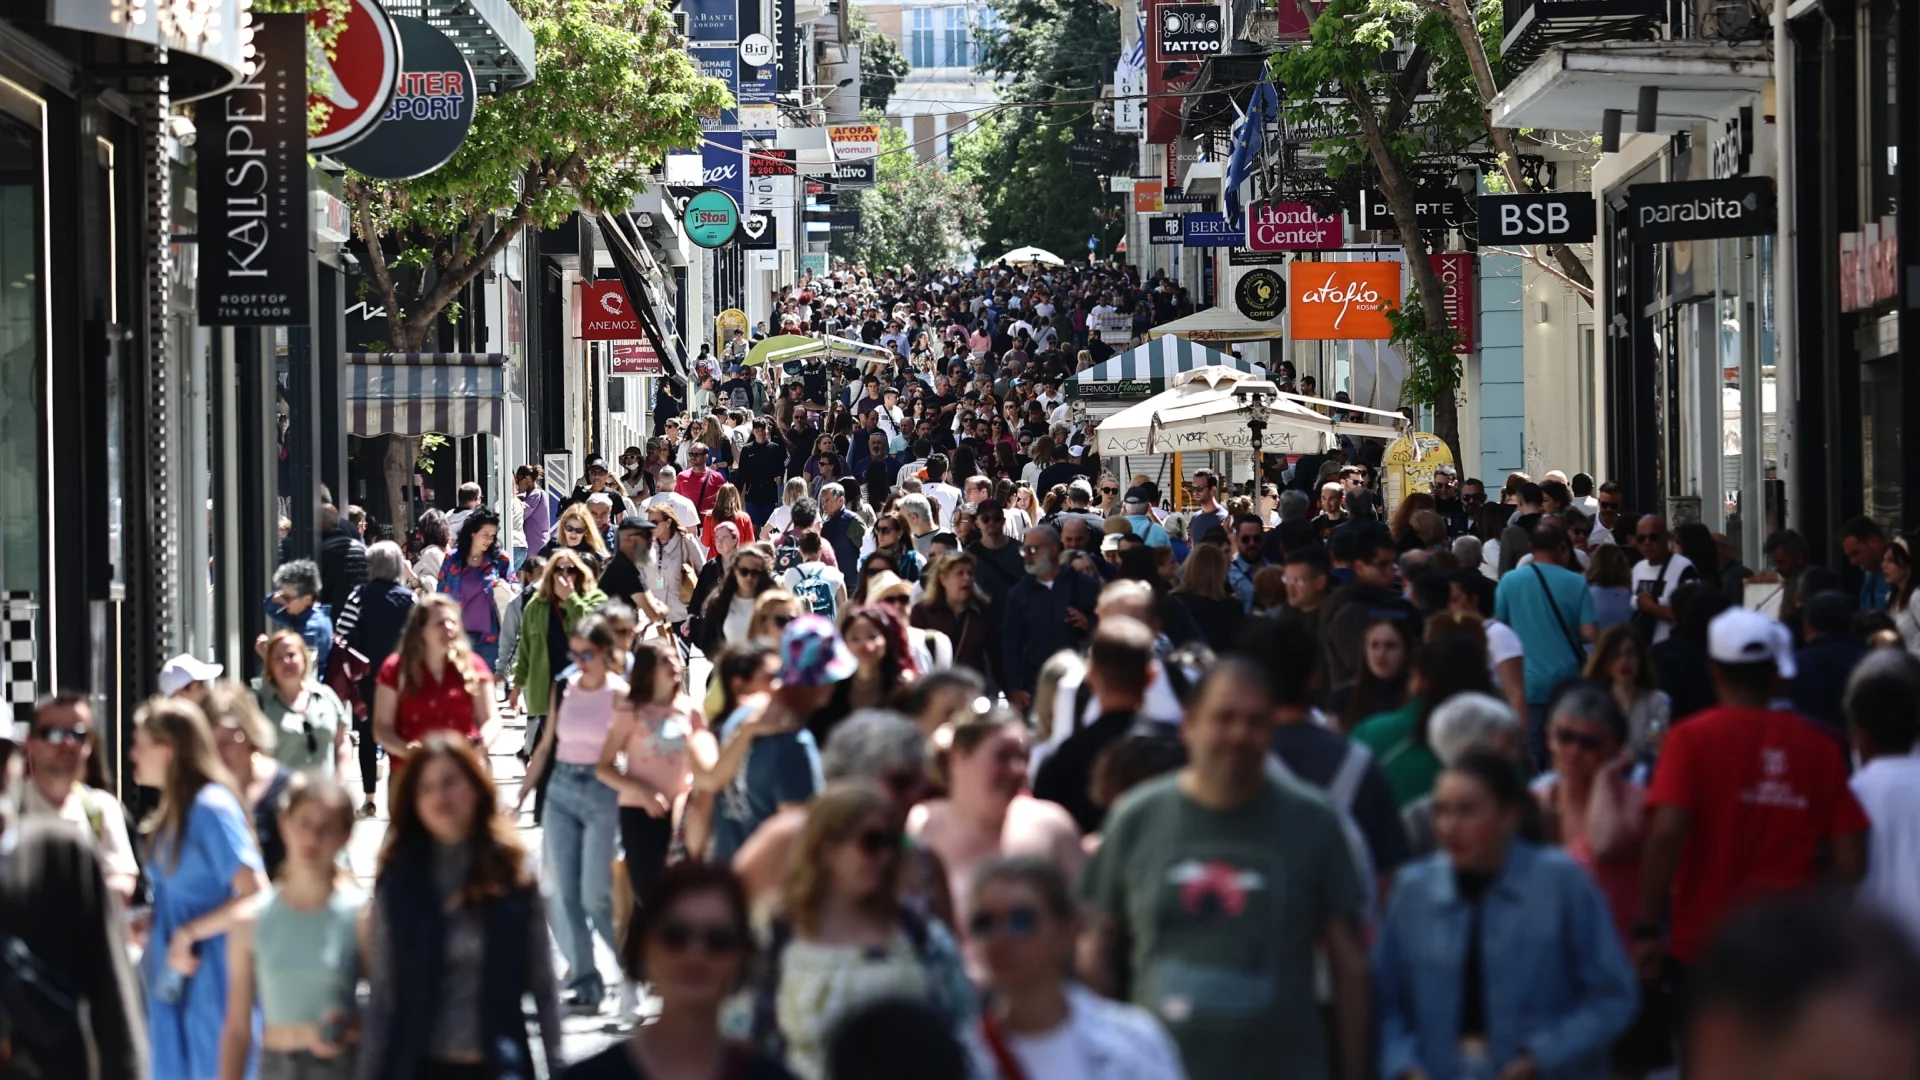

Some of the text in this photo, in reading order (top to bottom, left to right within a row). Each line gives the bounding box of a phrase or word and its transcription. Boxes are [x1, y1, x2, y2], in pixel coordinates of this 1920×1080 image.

[690, 13, 734, 21] ABANTE
[745, 44, 769, 56] Big
[1163, 40, 1220, 52] TATTOO
[834, 127, 873, 135] ΑΓΟΡΑ
[836, 146, 872, 154] woman
[1639, 197, 1742, 228] parabita
[1500, 202, 1571, 236] BSB
[1257, 224, 1327, 244] Center
[219, 294, 288, 305] ROOFTOP
[217, 307, 291, 317] 7th FLOOR
[587, 320, 637, 330] ΑΝΕΜΟΣ
[1079, 380, 1150, 393] ERMOU Flower
